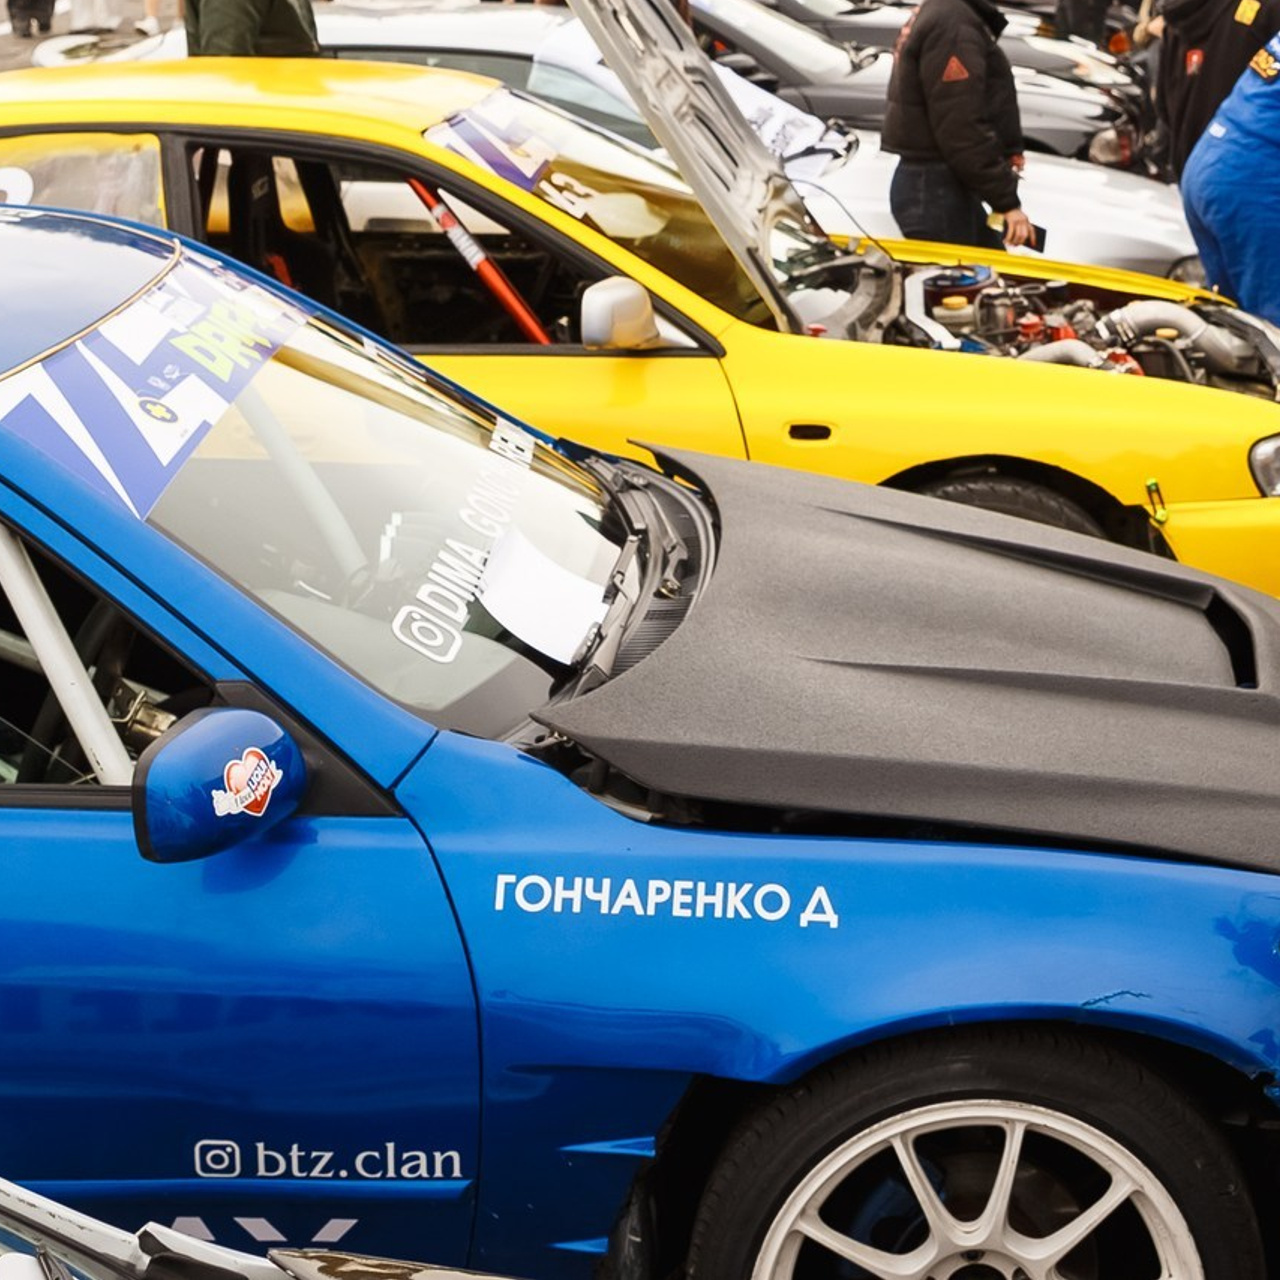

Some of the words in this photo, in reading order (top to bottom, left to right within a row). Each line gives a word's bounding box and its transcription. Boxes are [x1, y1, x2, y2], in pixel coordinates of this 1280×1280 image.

[494, 874, 791, 921] ГОНЧАРЕНКО
[799, 886, 839, 928] Д
[255, 1141, 463, 1178] btz.clan
